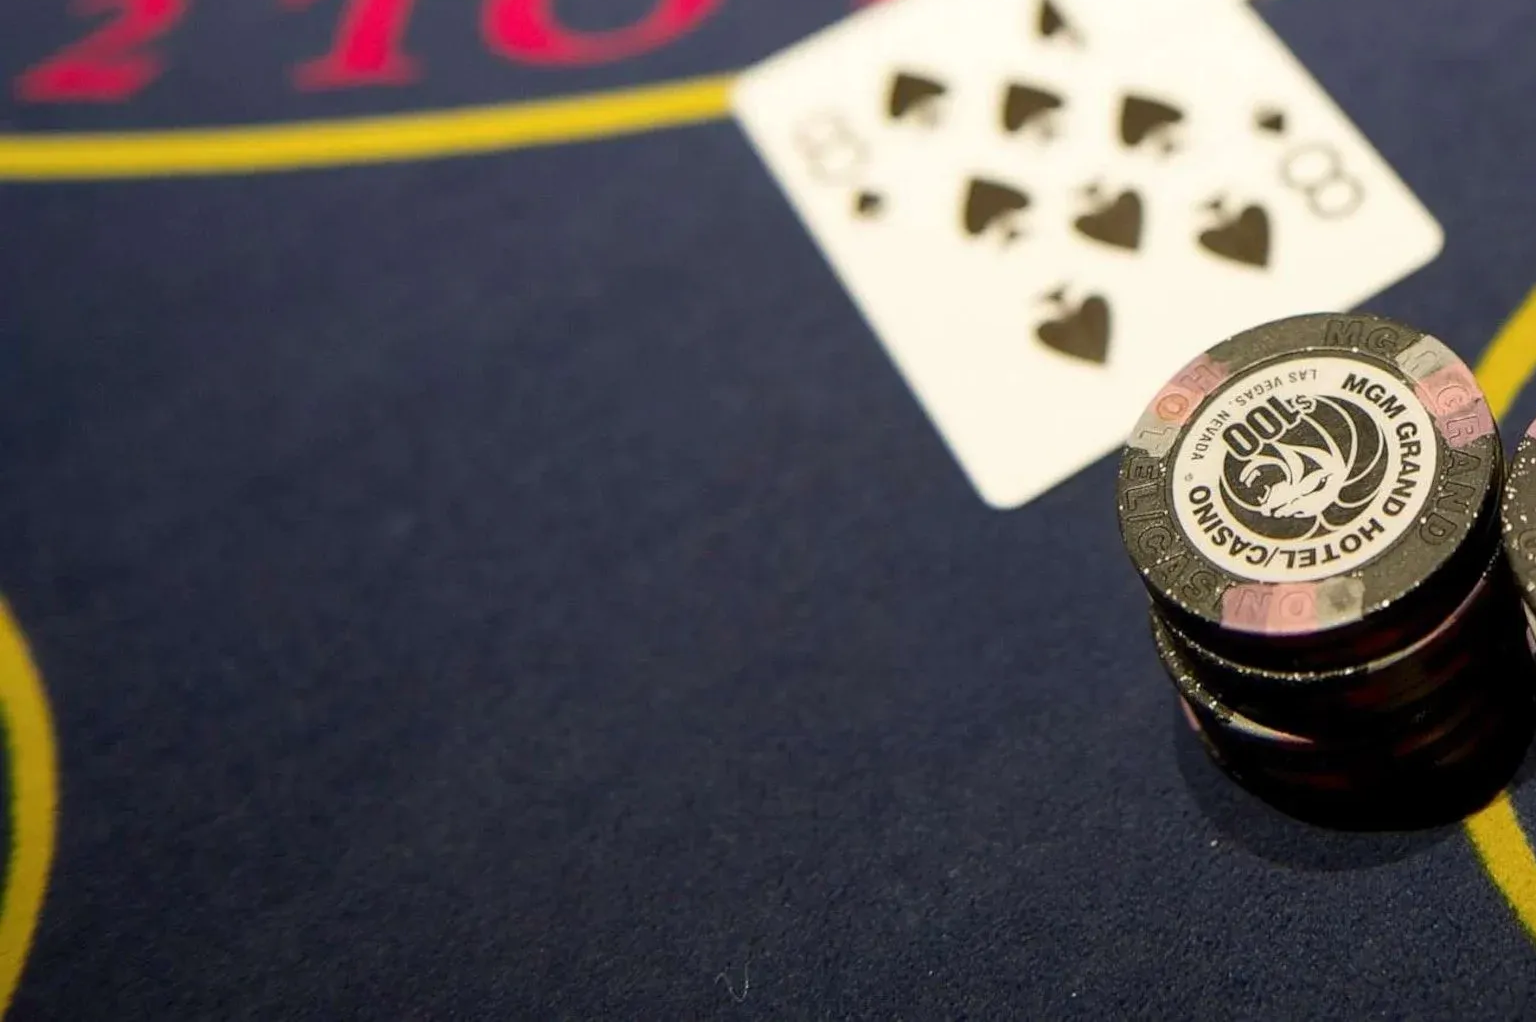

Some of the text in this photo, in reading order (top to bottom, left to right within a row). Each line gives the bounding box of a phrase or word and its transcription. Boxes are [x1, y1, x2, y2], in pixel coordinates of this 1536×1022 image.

[1277, 141, 1365, 220] 8
[1289, 369, 1317, 383] LAS
[1190, 409, 1230, 461] NEVADA
[1222, 394, 1316, 458] $100
[1188, 373, 1422, 569] MGM GRAND HOTEL/CASINO
